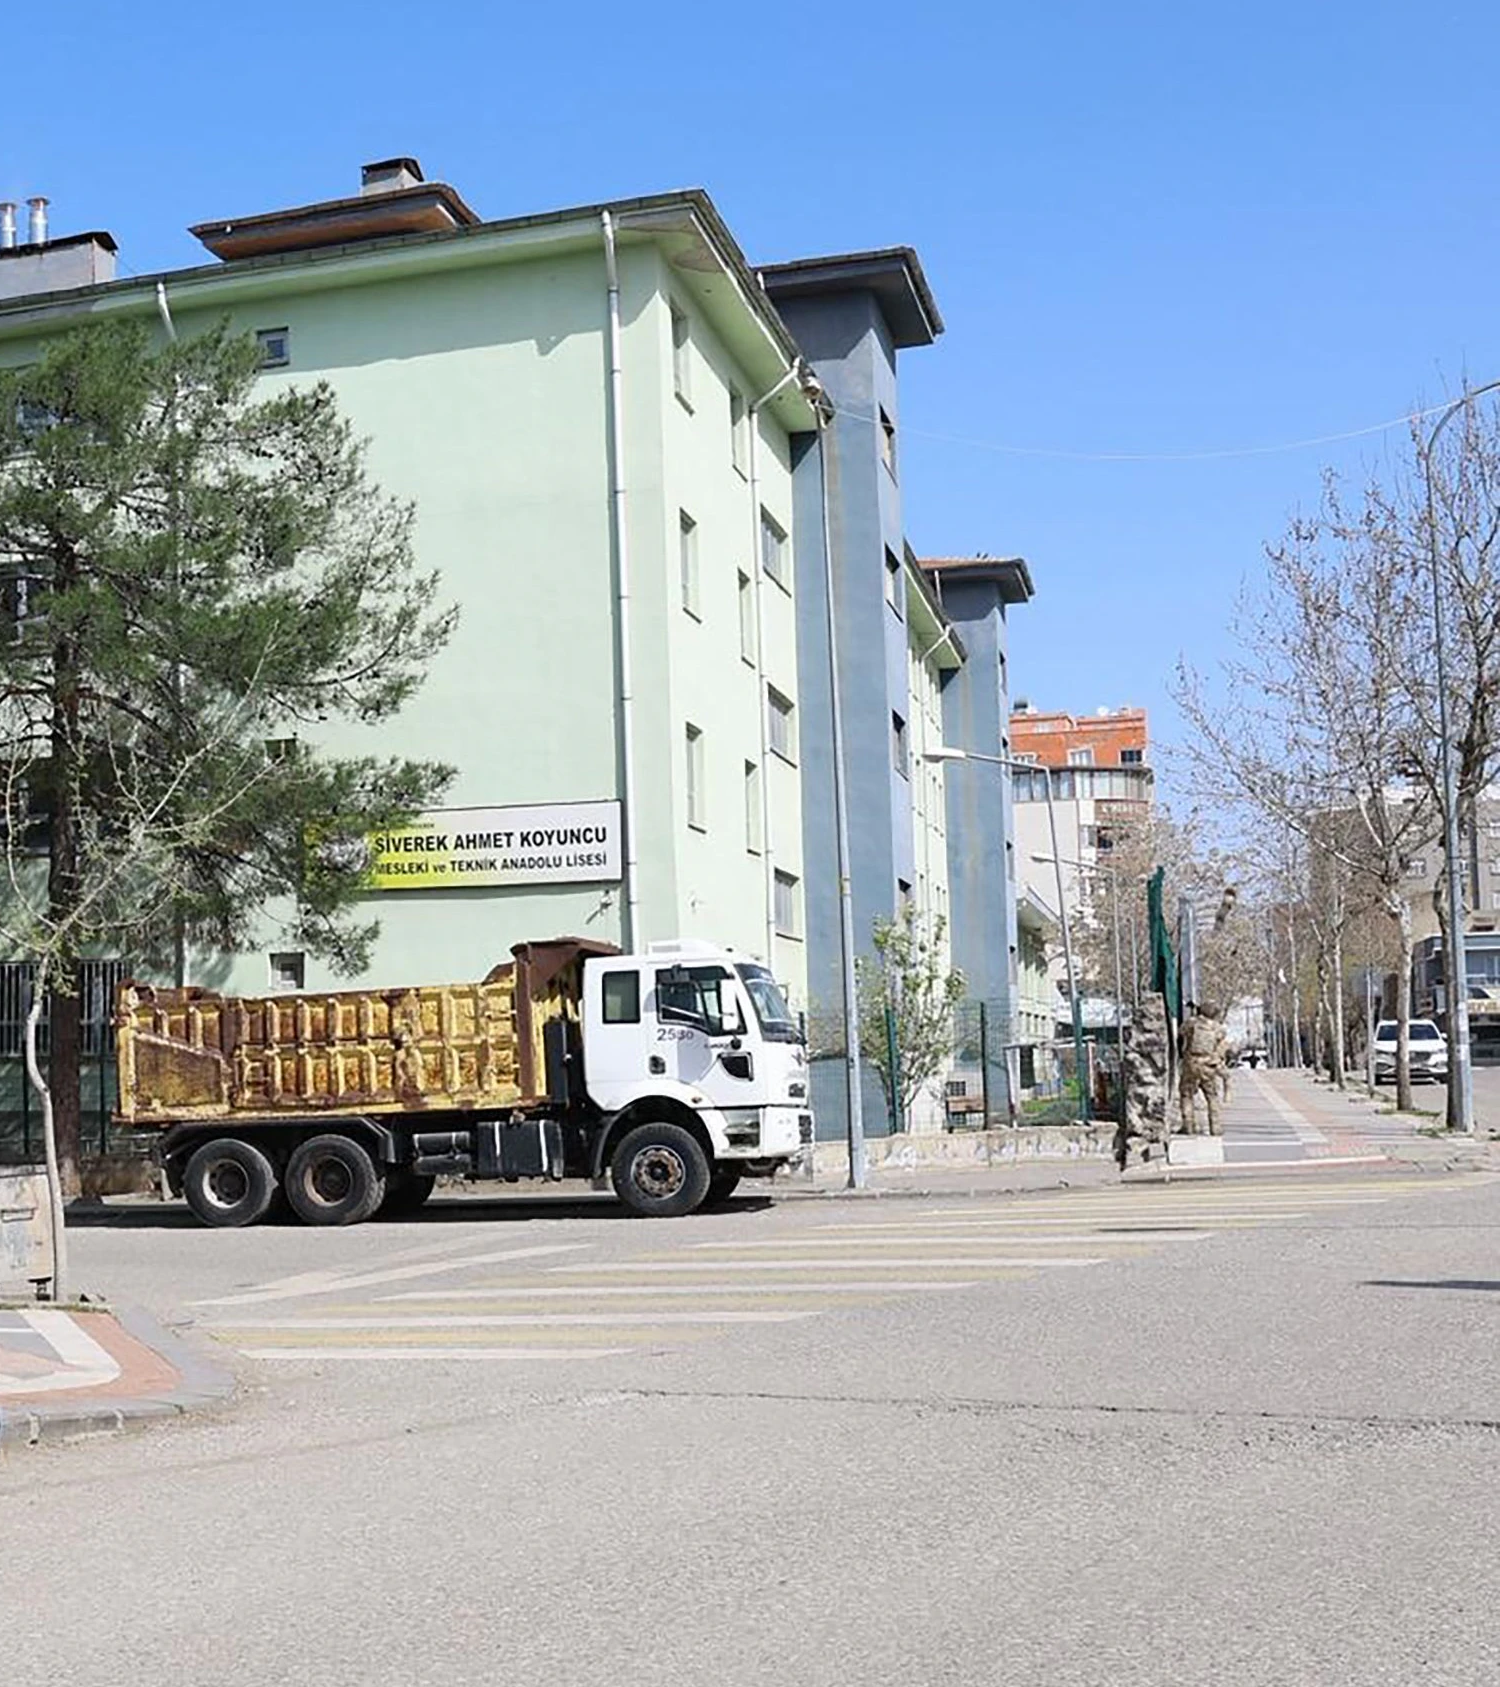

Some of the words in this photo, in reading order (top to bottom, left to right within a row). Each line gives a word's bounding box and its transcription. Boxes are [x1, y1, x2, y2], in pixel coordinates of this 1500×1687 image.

[375, 833, 449, 853] SİVEREK
[453, 831, 514, 850] AHMET
[520, 827, 607, 848] KOYUNCU
[432, 864, 446, 873] ve
[450, 857, 498, 872] TEKNİK
[501, 855, 562, 870] ANADOLU
[566, 850, 607, 867] LİSESİ
